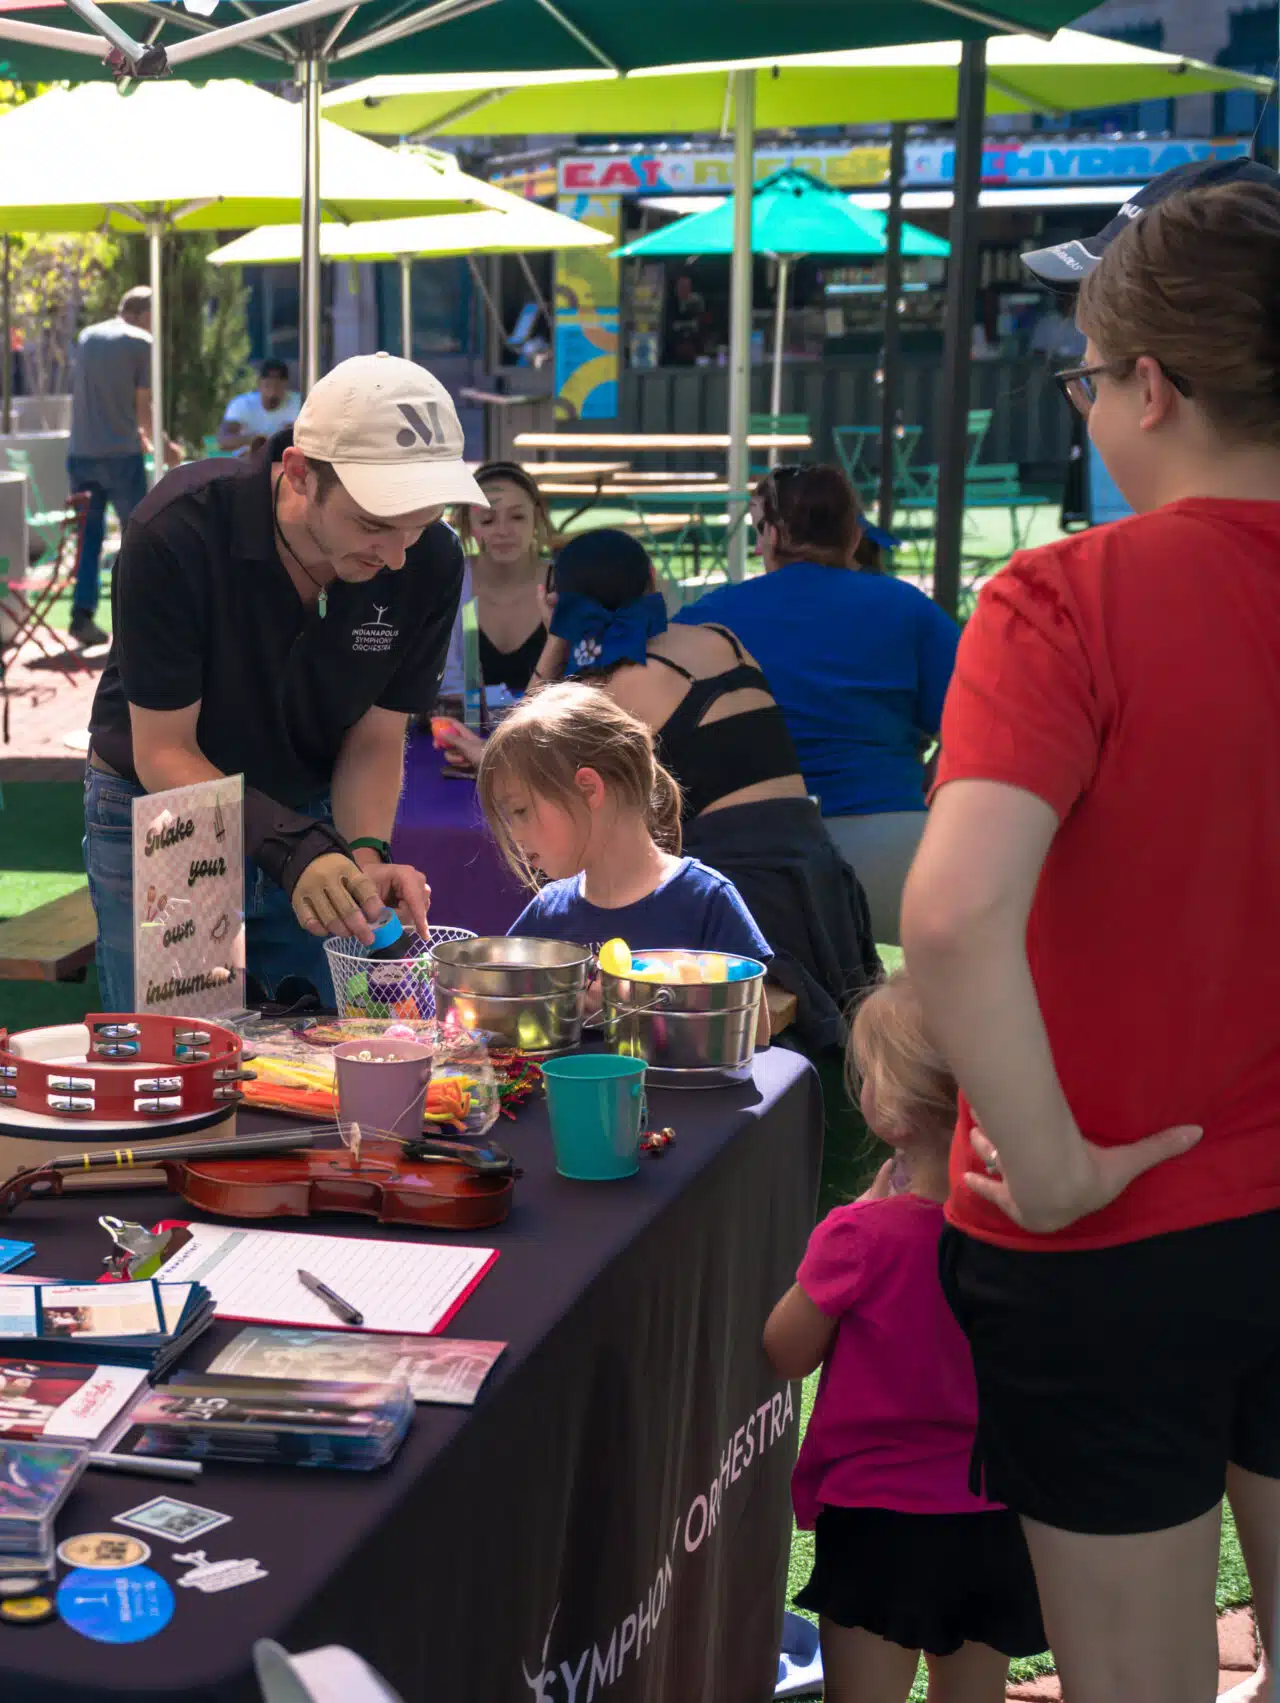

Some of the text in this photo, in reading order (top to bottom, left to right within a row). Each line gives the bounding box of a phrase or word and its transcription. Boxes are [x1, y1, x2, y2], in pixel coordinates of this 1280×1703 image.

[563, 160, 663, 189] EAT
[351, 628, 399, 637] INDIANAPOLIS
[355, 636, 393, 645] SYMPHONY
[352, 643, 391, 652] ORCHESTRA
[144, 815, 195, 857] Make
[187, 856, 227, 887] your
[162, 918, 196, 948] own
[684, 1379, 794, 1552] ORHESTRA
